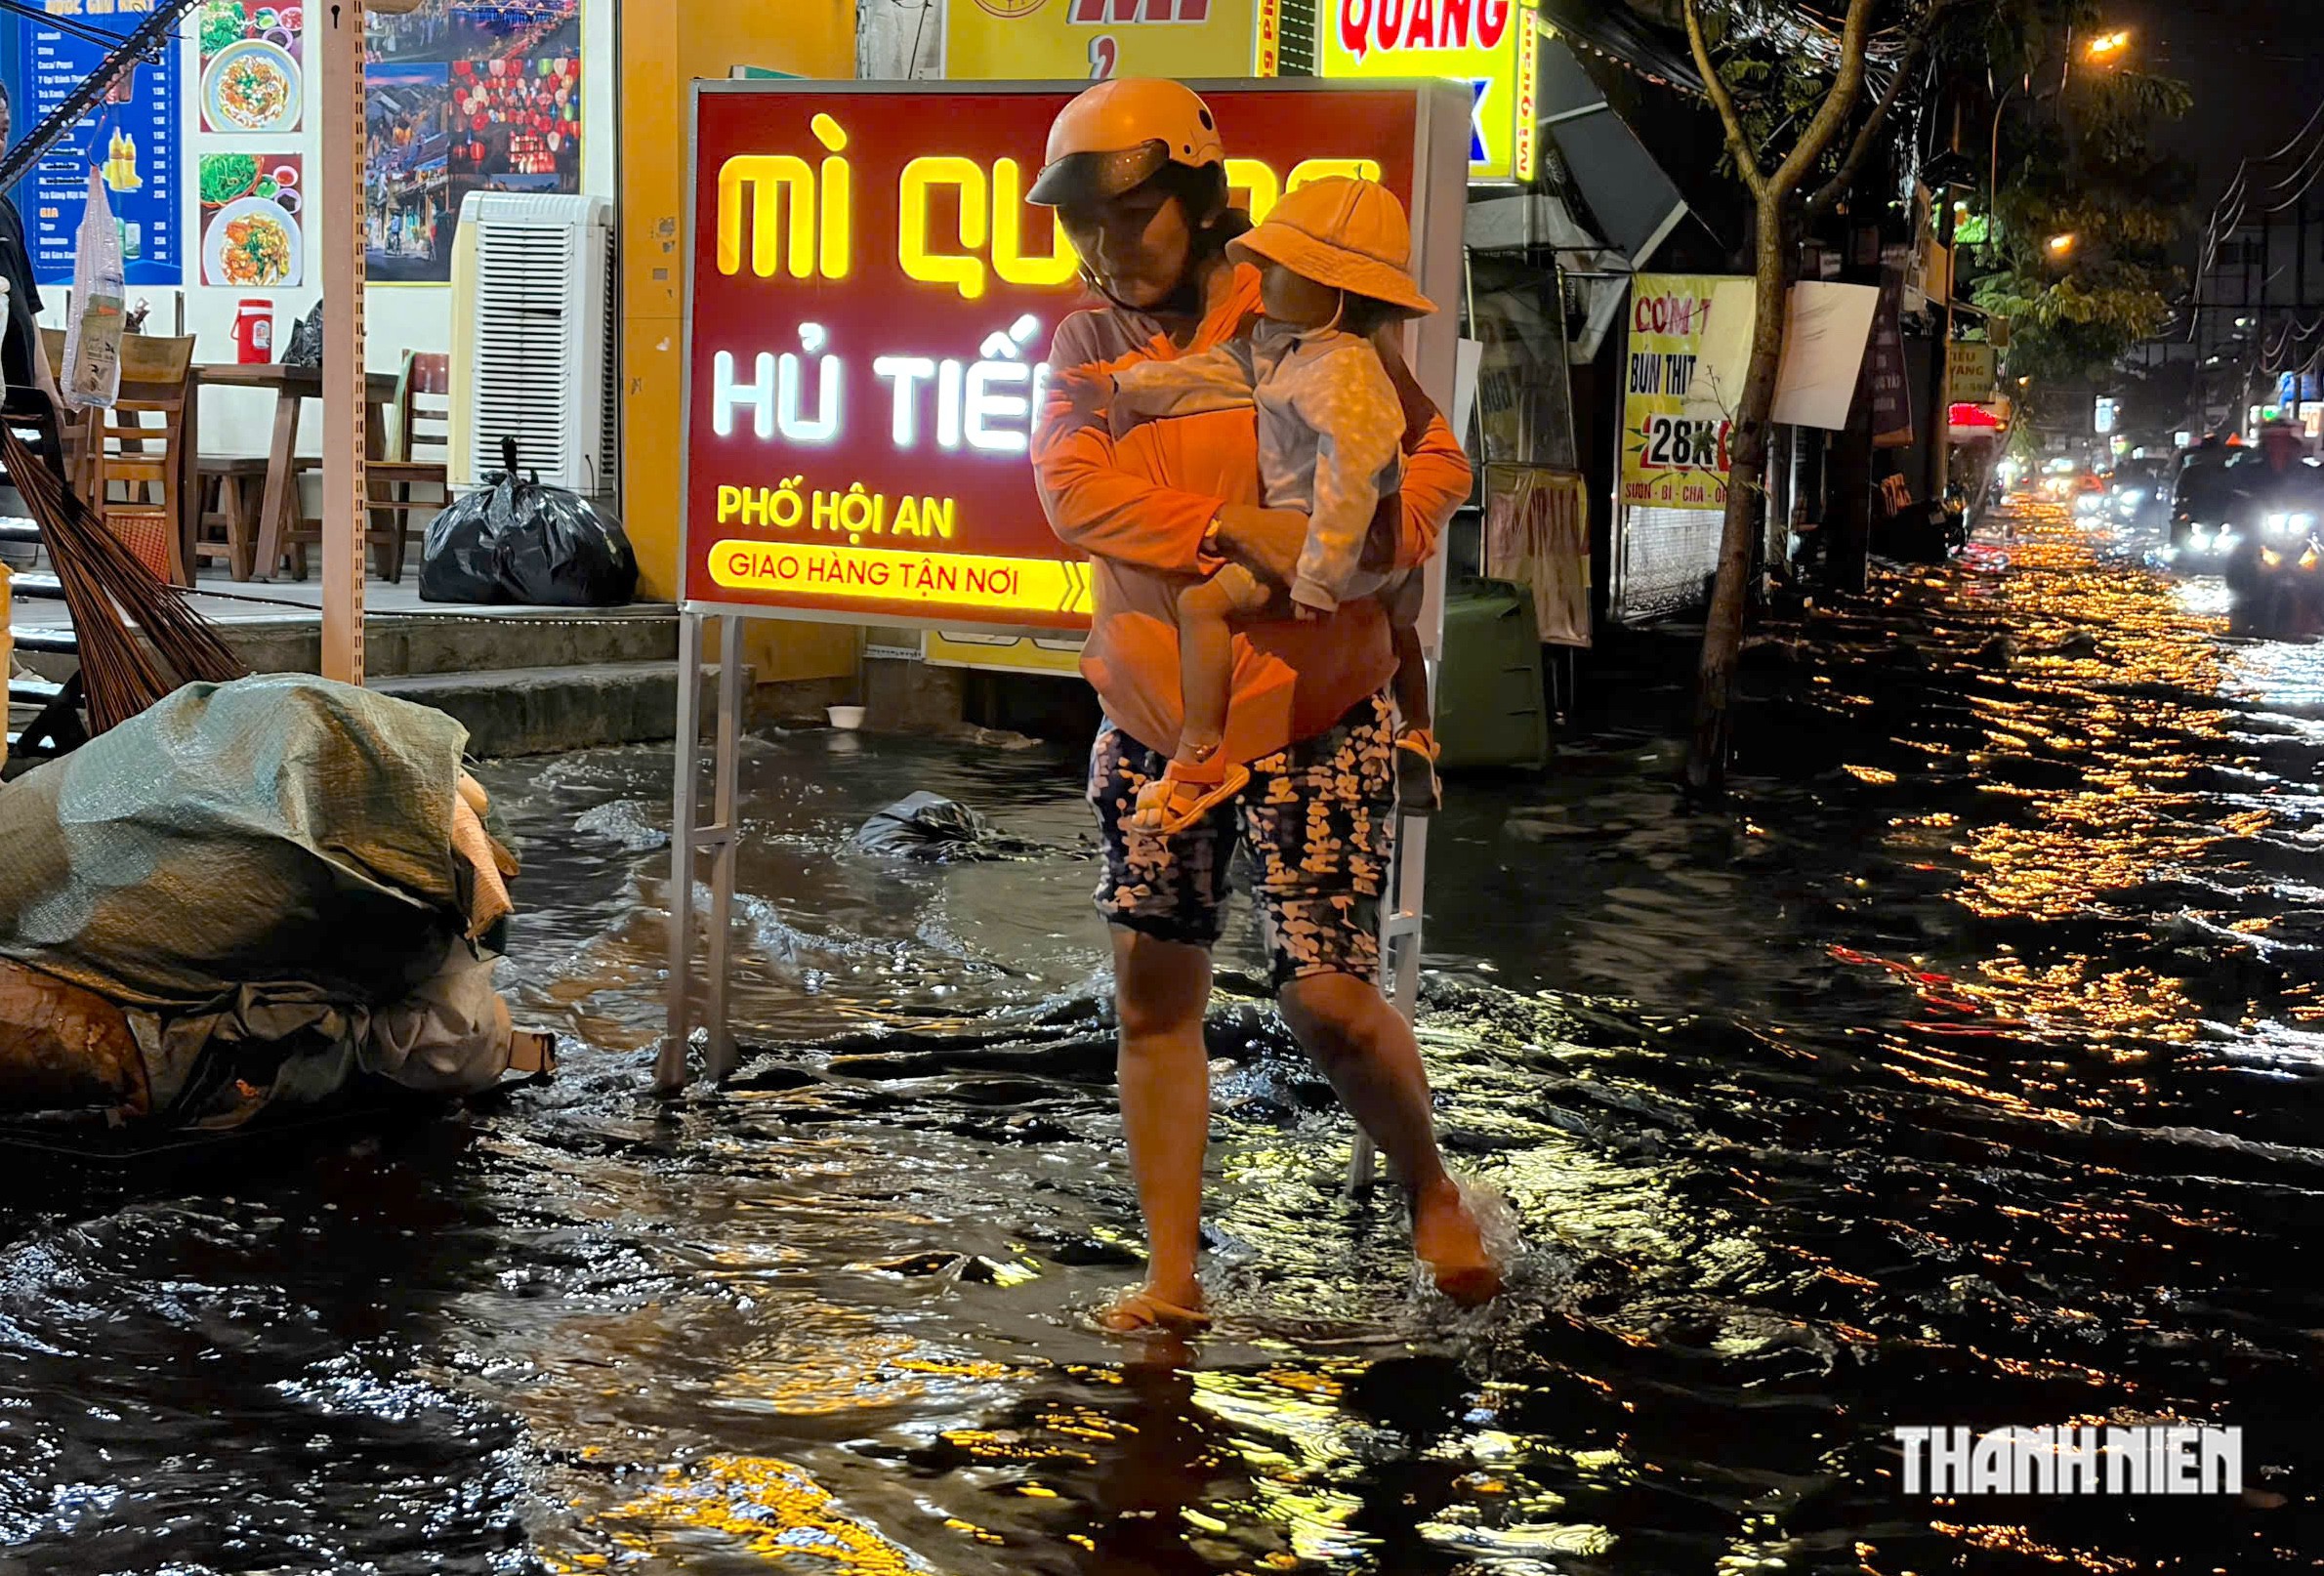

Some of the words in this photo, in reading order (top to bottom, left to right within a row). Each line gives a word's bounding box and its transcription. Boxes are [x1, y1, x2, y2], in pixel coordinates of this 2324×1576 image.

[712, 321, 840, 441] HỦ
[1630, 345, 1662, 394] BÚN
[1650, 418, 1716, 465] 28K
[717, 475, 804, 528] PHỐ
[811, 481, 882, 544] HỘI
[892, 497, 954, 538] AN
[728, 551, 800, 581] GIAO
[808, 550, 891, 586] HÀNG
[903, 558, 958, 599] TẬN
[965, 566, 1018, 597] NƠI
